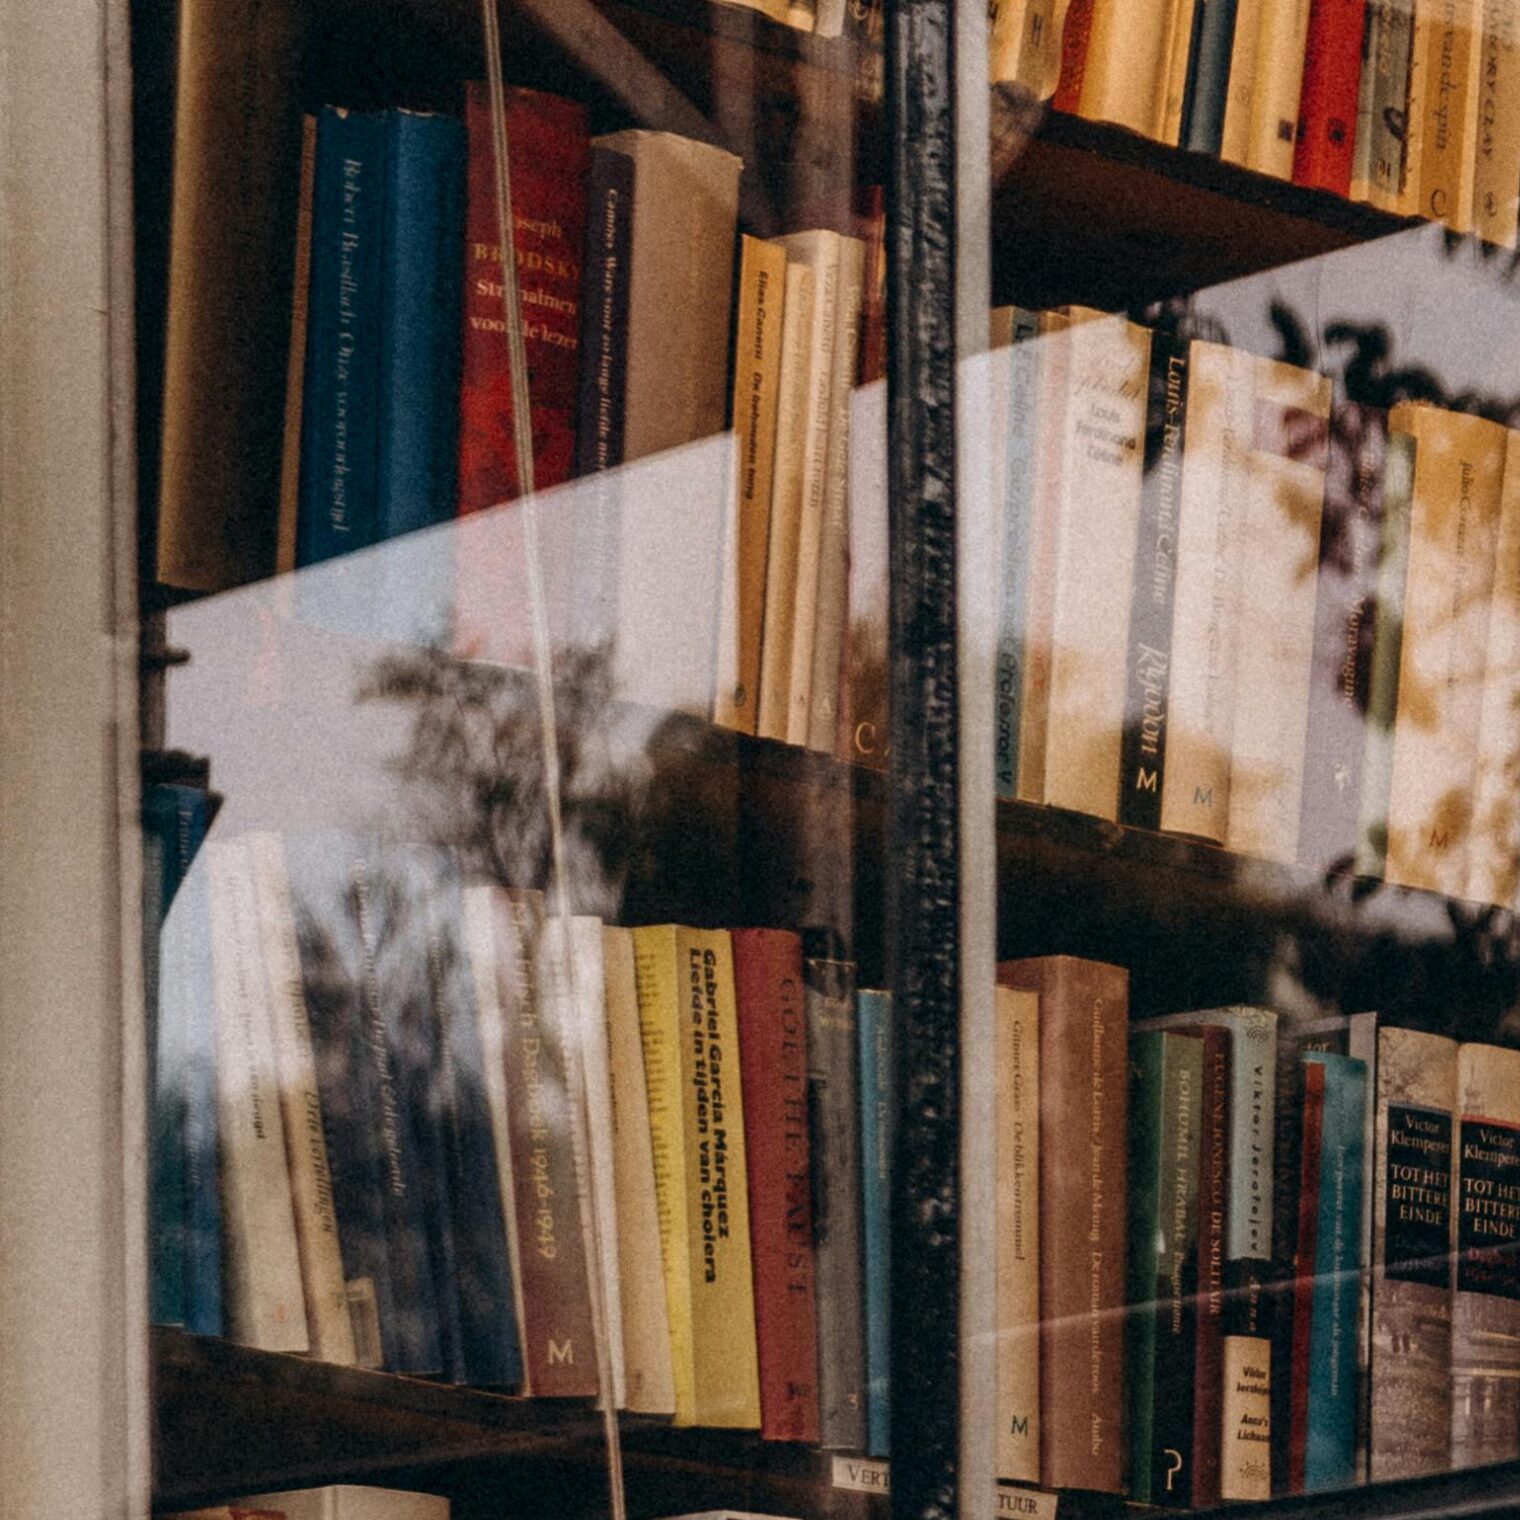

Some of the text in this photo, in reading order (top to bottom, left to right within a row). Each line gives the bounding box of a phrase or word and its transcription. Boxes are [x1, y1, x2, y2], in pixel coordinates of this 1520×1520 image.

[700, 948, 731, 1239] Gabriel García Márquez
[687, 947, 718, 1284] Liefde in tijden van cholera
[1175, 1069, 1191, 1161] BOHUMIL
[1390, 1164, 1421, 1182] TOT
[1463, 1177, 1495, 1196] TOT
[1397, 1204, 1442, 1226] EINDE
[1472, 1217, 1517, 1240] EINDE
